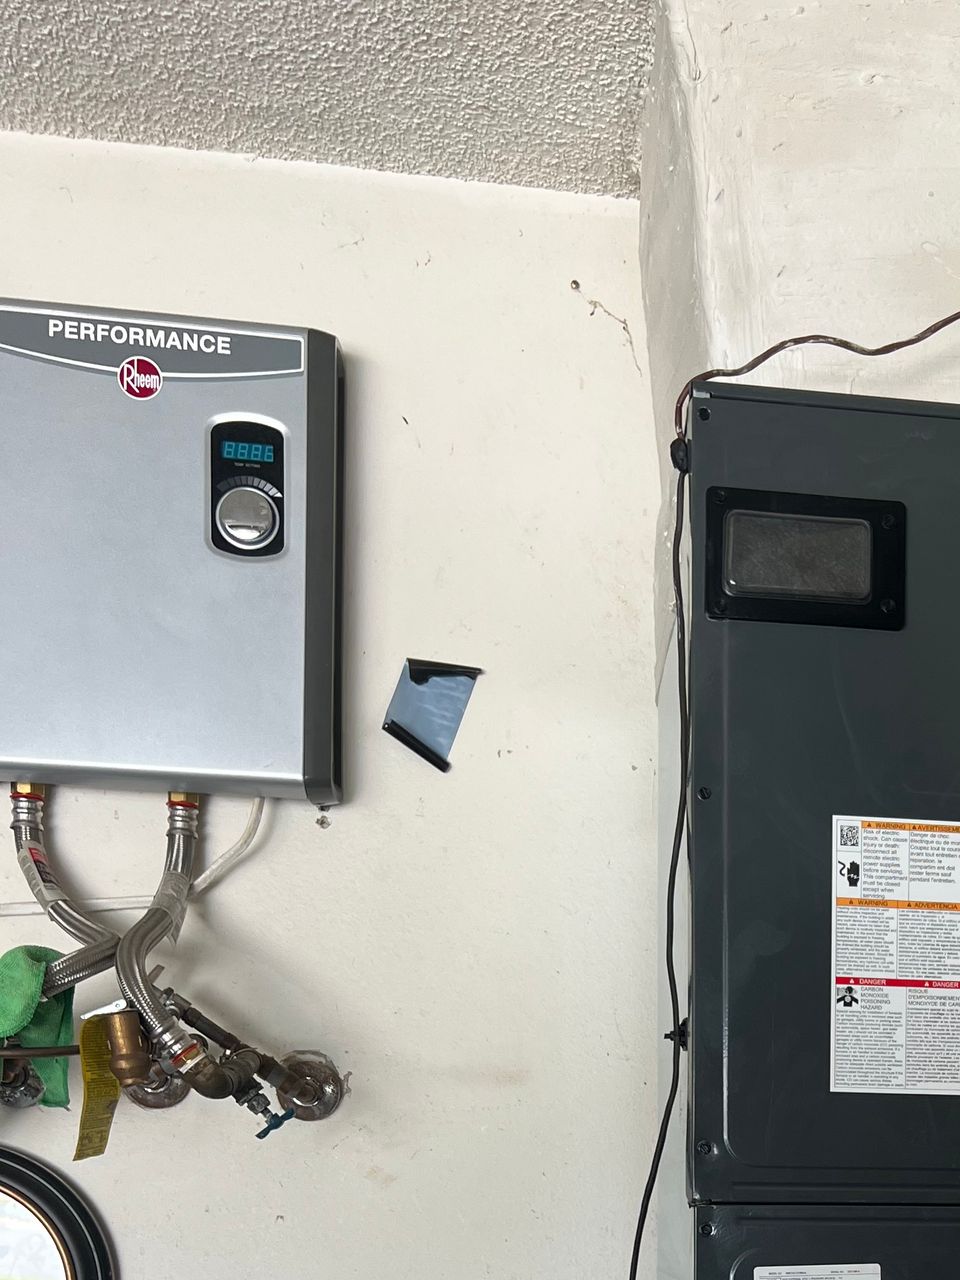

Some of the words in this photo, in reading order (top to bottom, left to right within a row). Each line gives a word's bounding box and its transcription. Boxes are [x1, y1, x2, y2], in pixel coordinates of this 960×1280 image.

[48, 319, 231, 355] PERFORMANCE
[123, 358, 160, 393] Rheem
[875, 822, 906, 830] WARNING
[914, 902, 958, 910] ADVERTENCIA
